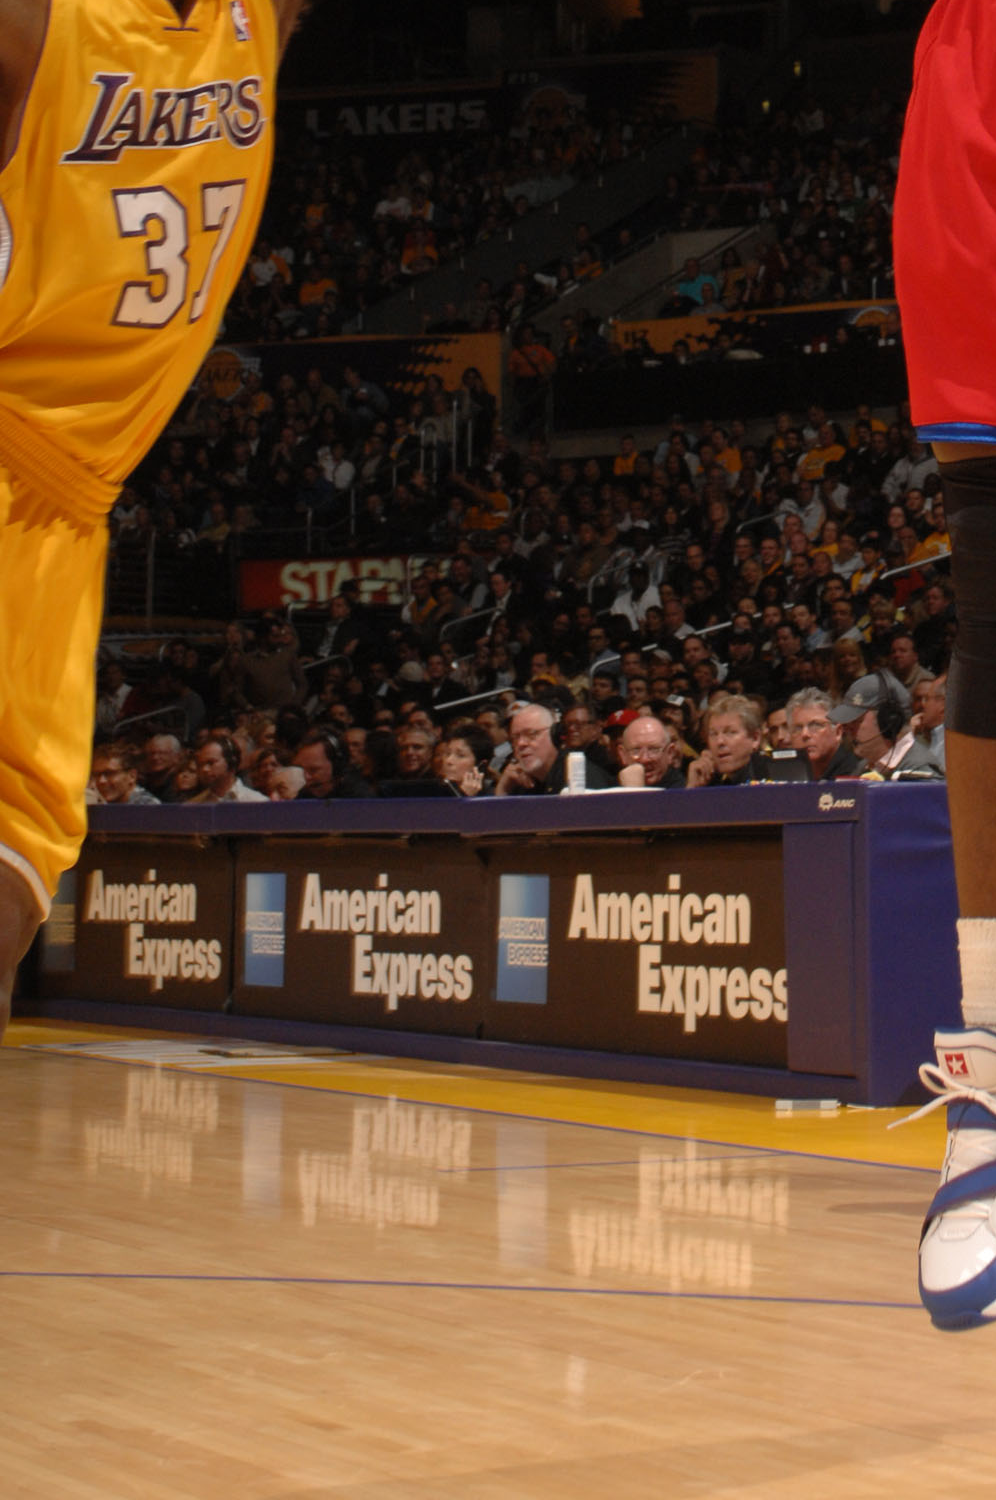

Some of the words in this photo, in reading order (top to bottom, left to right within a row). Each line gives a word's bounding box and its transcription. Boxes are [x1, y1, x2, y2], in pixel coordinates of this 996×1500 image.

[306, 100, 487, 138] LAKERS
[110, 178, 247, 329] 37
[87, 869, 196, 922] American
[300, 873, 440, 934] American
[568, 874, 750, 944] American
[127, 923, 221, 989] Express
[354, 935, 473, 1011] Express
[638, 944, 788, 1032] Express
